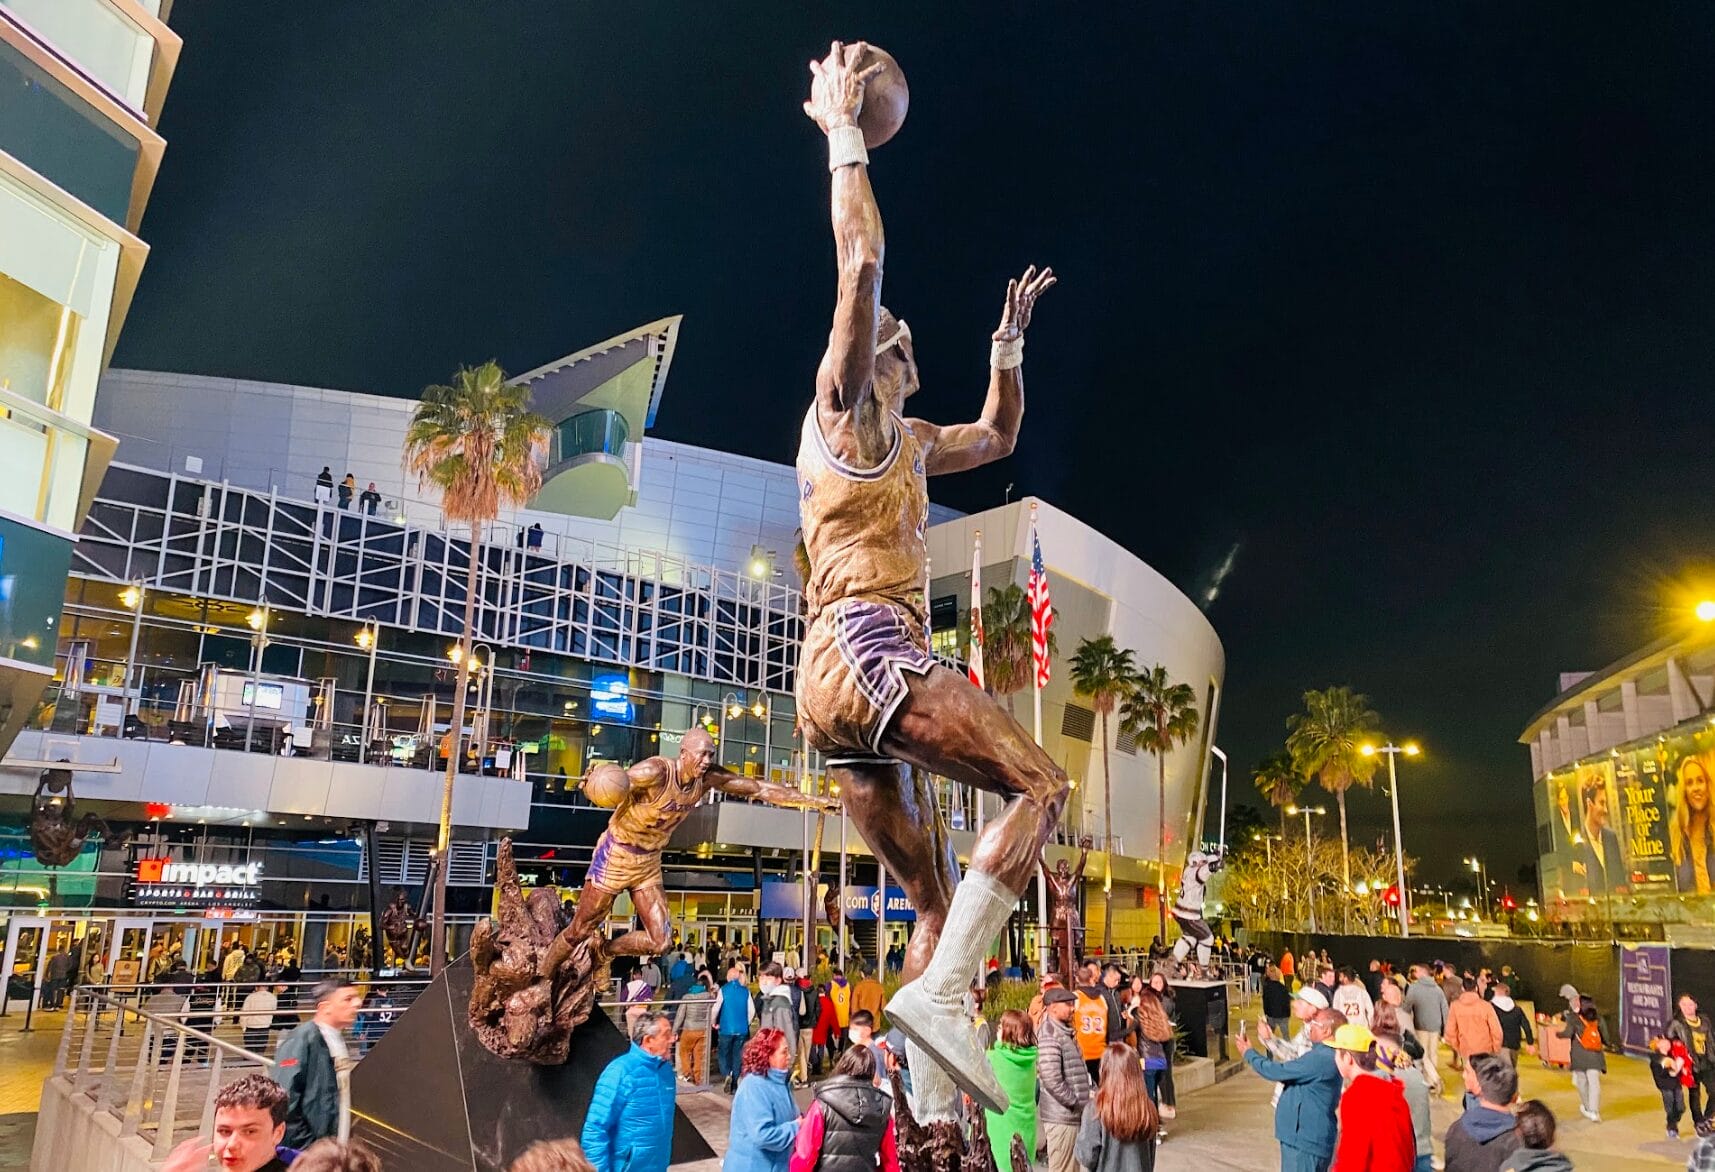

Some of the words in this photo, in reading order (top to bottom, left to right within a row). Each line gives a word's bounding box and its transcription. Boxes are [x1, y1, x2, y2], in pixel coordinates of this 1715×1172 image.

[1625, 787, 1655, 803] Your
[1626, 806, 1660, 824] Place
[1636, 823, 1652, 837] or
[1632, 838, 1664, 856] Mine
[161, 857, 258, 889] impact
[138, 889, 182, 899] SPORTS
[192, 889, 214, 899] BAR
[223, 889, 256, 899] GRILL
[887, 898, 914, 910] AREN
[1344, 1003, 1360, 1016] 23
